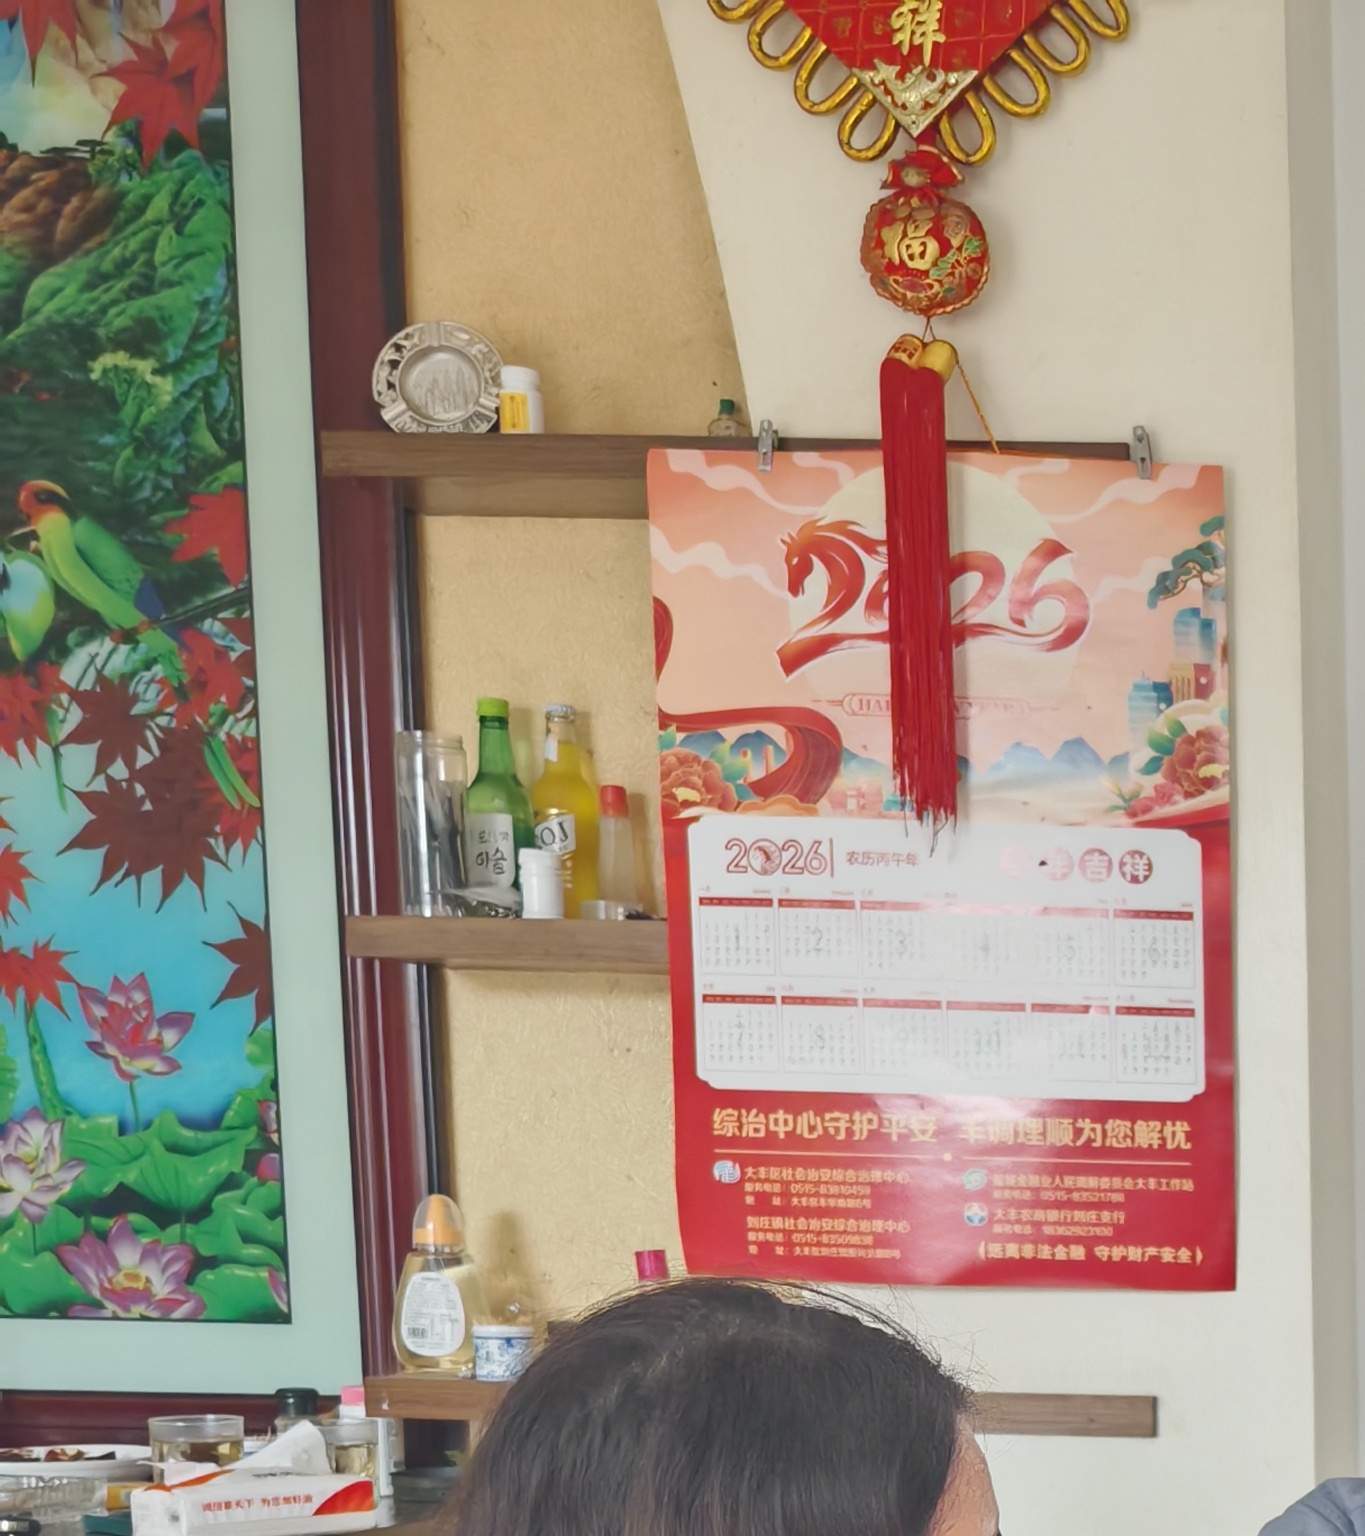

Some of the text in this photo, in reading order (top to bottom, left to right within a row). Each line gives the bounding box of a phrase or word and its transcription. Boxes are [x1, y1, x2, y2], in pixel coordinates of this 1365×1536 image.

[891, 0, 947, 68] 祥
[880, 216, 941, 271] 福
[776, 517, 1092, 680] 226
[724, 837, 828, 877] 2026
[1000, 848, 1153, 884] 年吉祥
[712, 1108, 938, 1143] 综治中心守护平安
